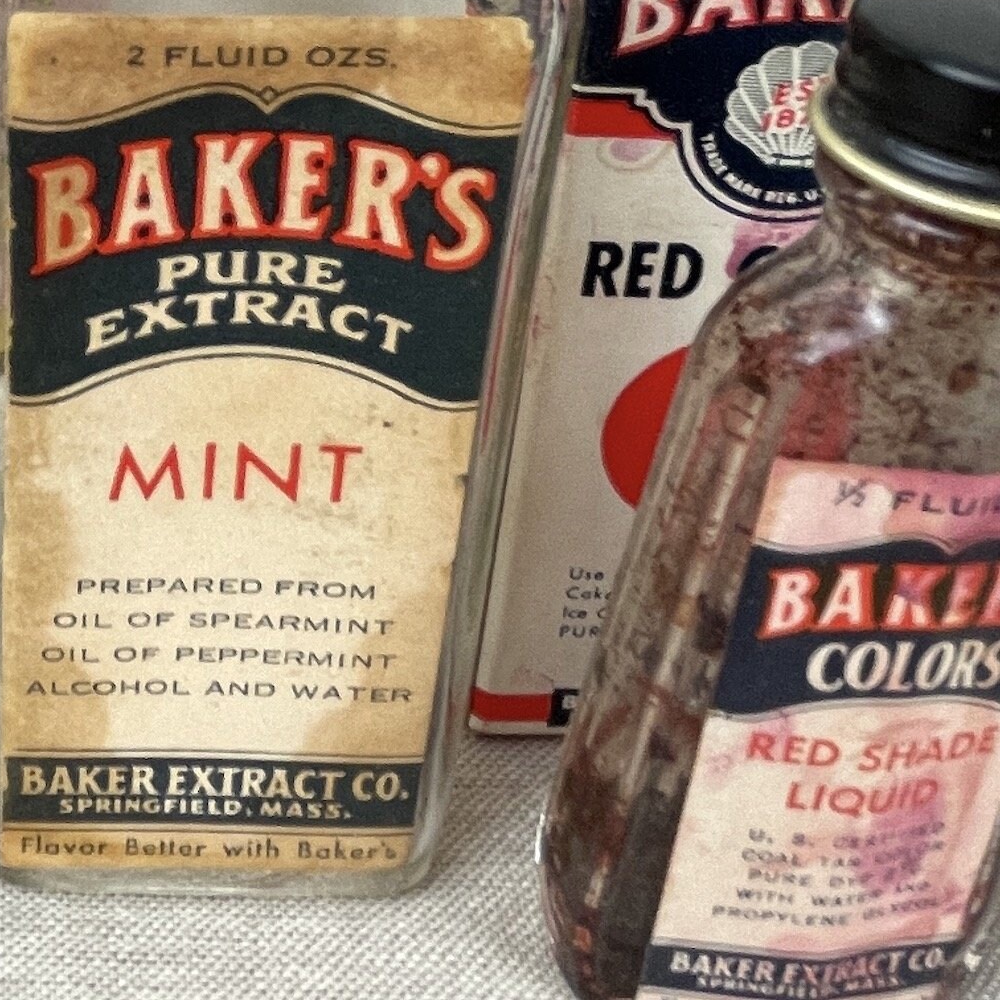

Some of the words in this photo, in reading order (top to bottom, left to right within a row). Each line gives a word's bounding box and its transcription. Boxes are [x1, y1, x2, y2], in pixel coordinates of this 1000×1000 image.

[127, 46, 144, 66] 2
[164, 46, 288, 68] FLUID
[305, 46, 397, 69] OZS.
[28, 130, 497, 276] BAKER'S
[156, 251, 346, 294] PURE
[581, 241, 704, 299] RED
[84, 291, 415, 356] EXTRACT
[108, 442, 364, 503] MINT
[76, 577, 262, 596] PREPARED
[275, 580, 376, 600] FROM
[756, 561, 1000, 641] BAKE
[53, 612, 112, 629] OIL
[127, 612, 174, 629] OF
[189, 612, 395, 636] SPEARMINT
[41, 647, 99, 664] OIL
[113, 647, 160, 664] OF
[175, 647, 398, 671] PEPPERMINT
[805, 639, 1000, 693] COLORS
[26, 680, 191, 697] ALCOHOL
[204, 681, 275, 698] AND
[292, 684, 412, 703] WATER
[746, 731, 841, 767] RED
[858, 725, 1000, 773] SHADE
[21, 765, 159, 797] BAKER
[168, 766, 345, 801] EXTRACT
[352, 770, 409, 801] CO.
[785, 778, 939, 818] LIQUID
[260, 801, 351, 820] MASS.
[20, 836, 107, 856] Flavor
[125, 838, 206, 858] Better
[222, 838, 280, 858] with
[299, 839, 397, 860] Baker's
[670, 951, 775, 983] BAKER
